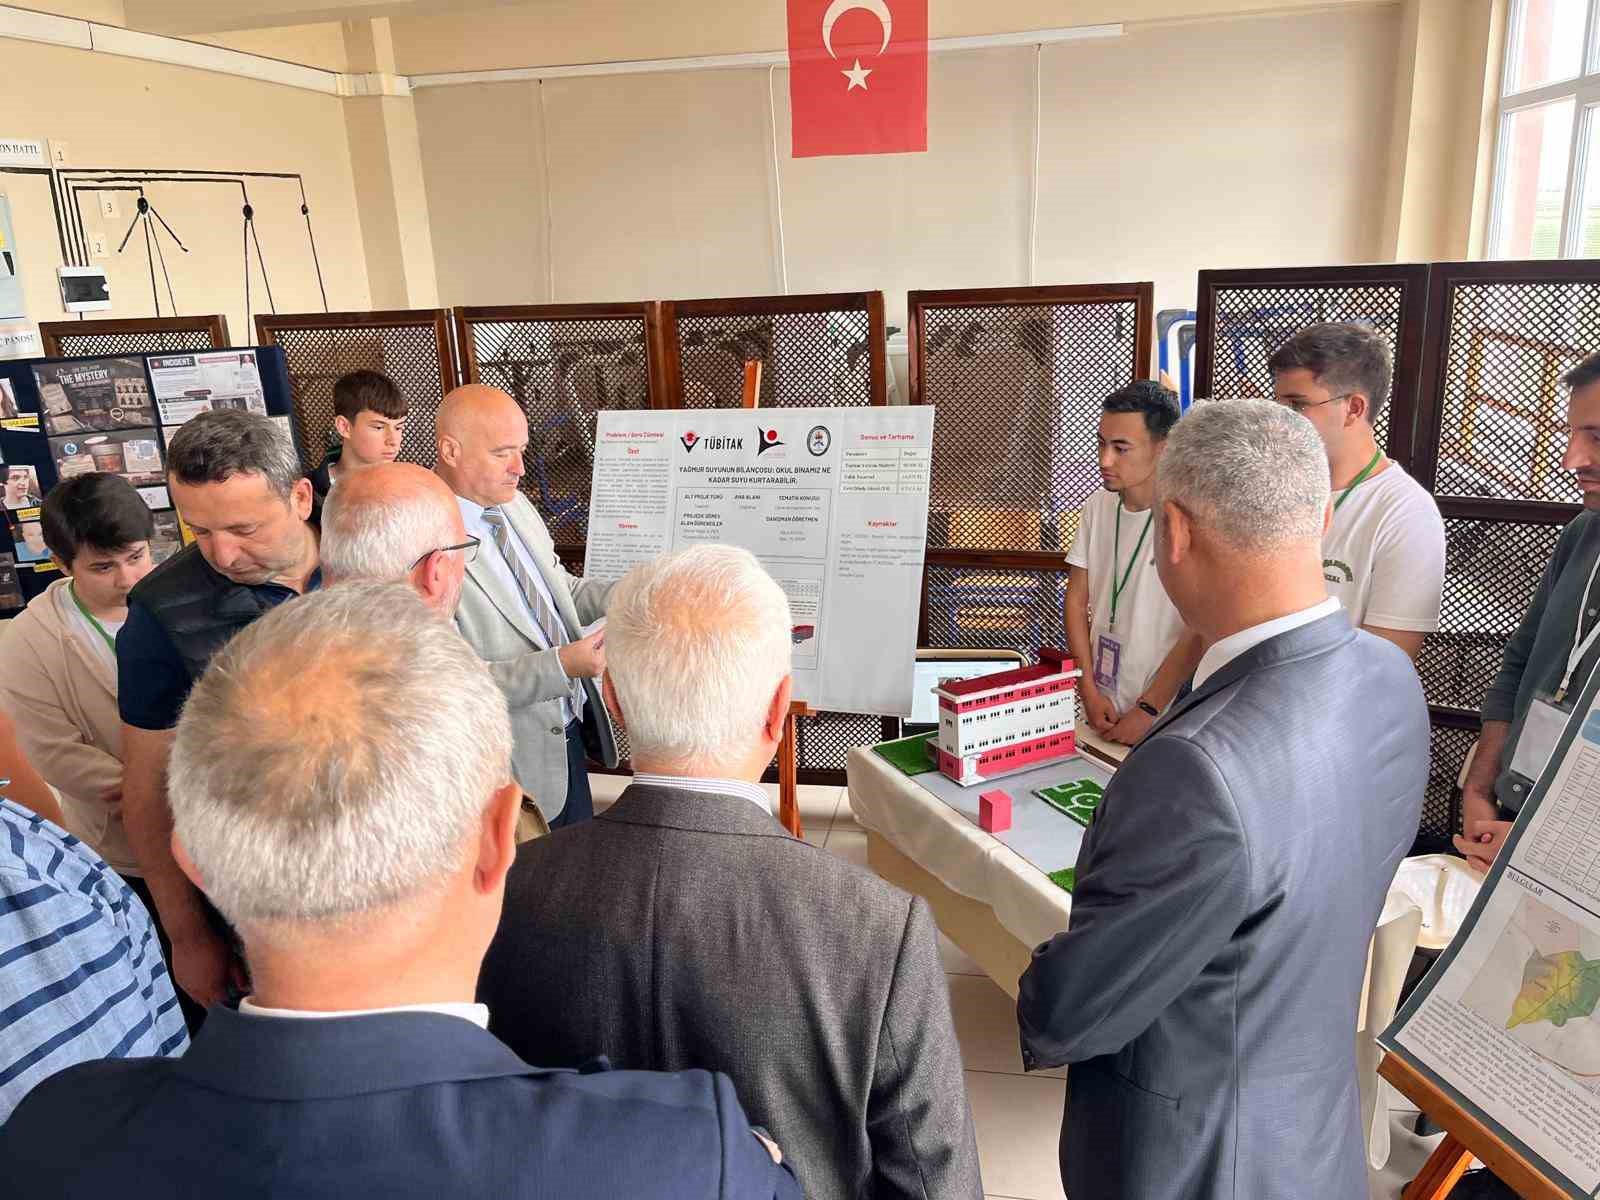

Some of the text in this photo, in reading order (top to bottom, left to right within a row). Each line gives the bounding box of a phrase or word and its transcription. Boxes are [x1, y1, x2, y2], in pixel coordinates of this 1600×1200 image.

[106, 202, 113, 213] 3
[95, 243, 102, 253] 2
[59, 369, 109, 385] THE MYSTERY
[704, 435, 743, 450] TÜBİTAK
[776, 466, 793, 474] OKUL
